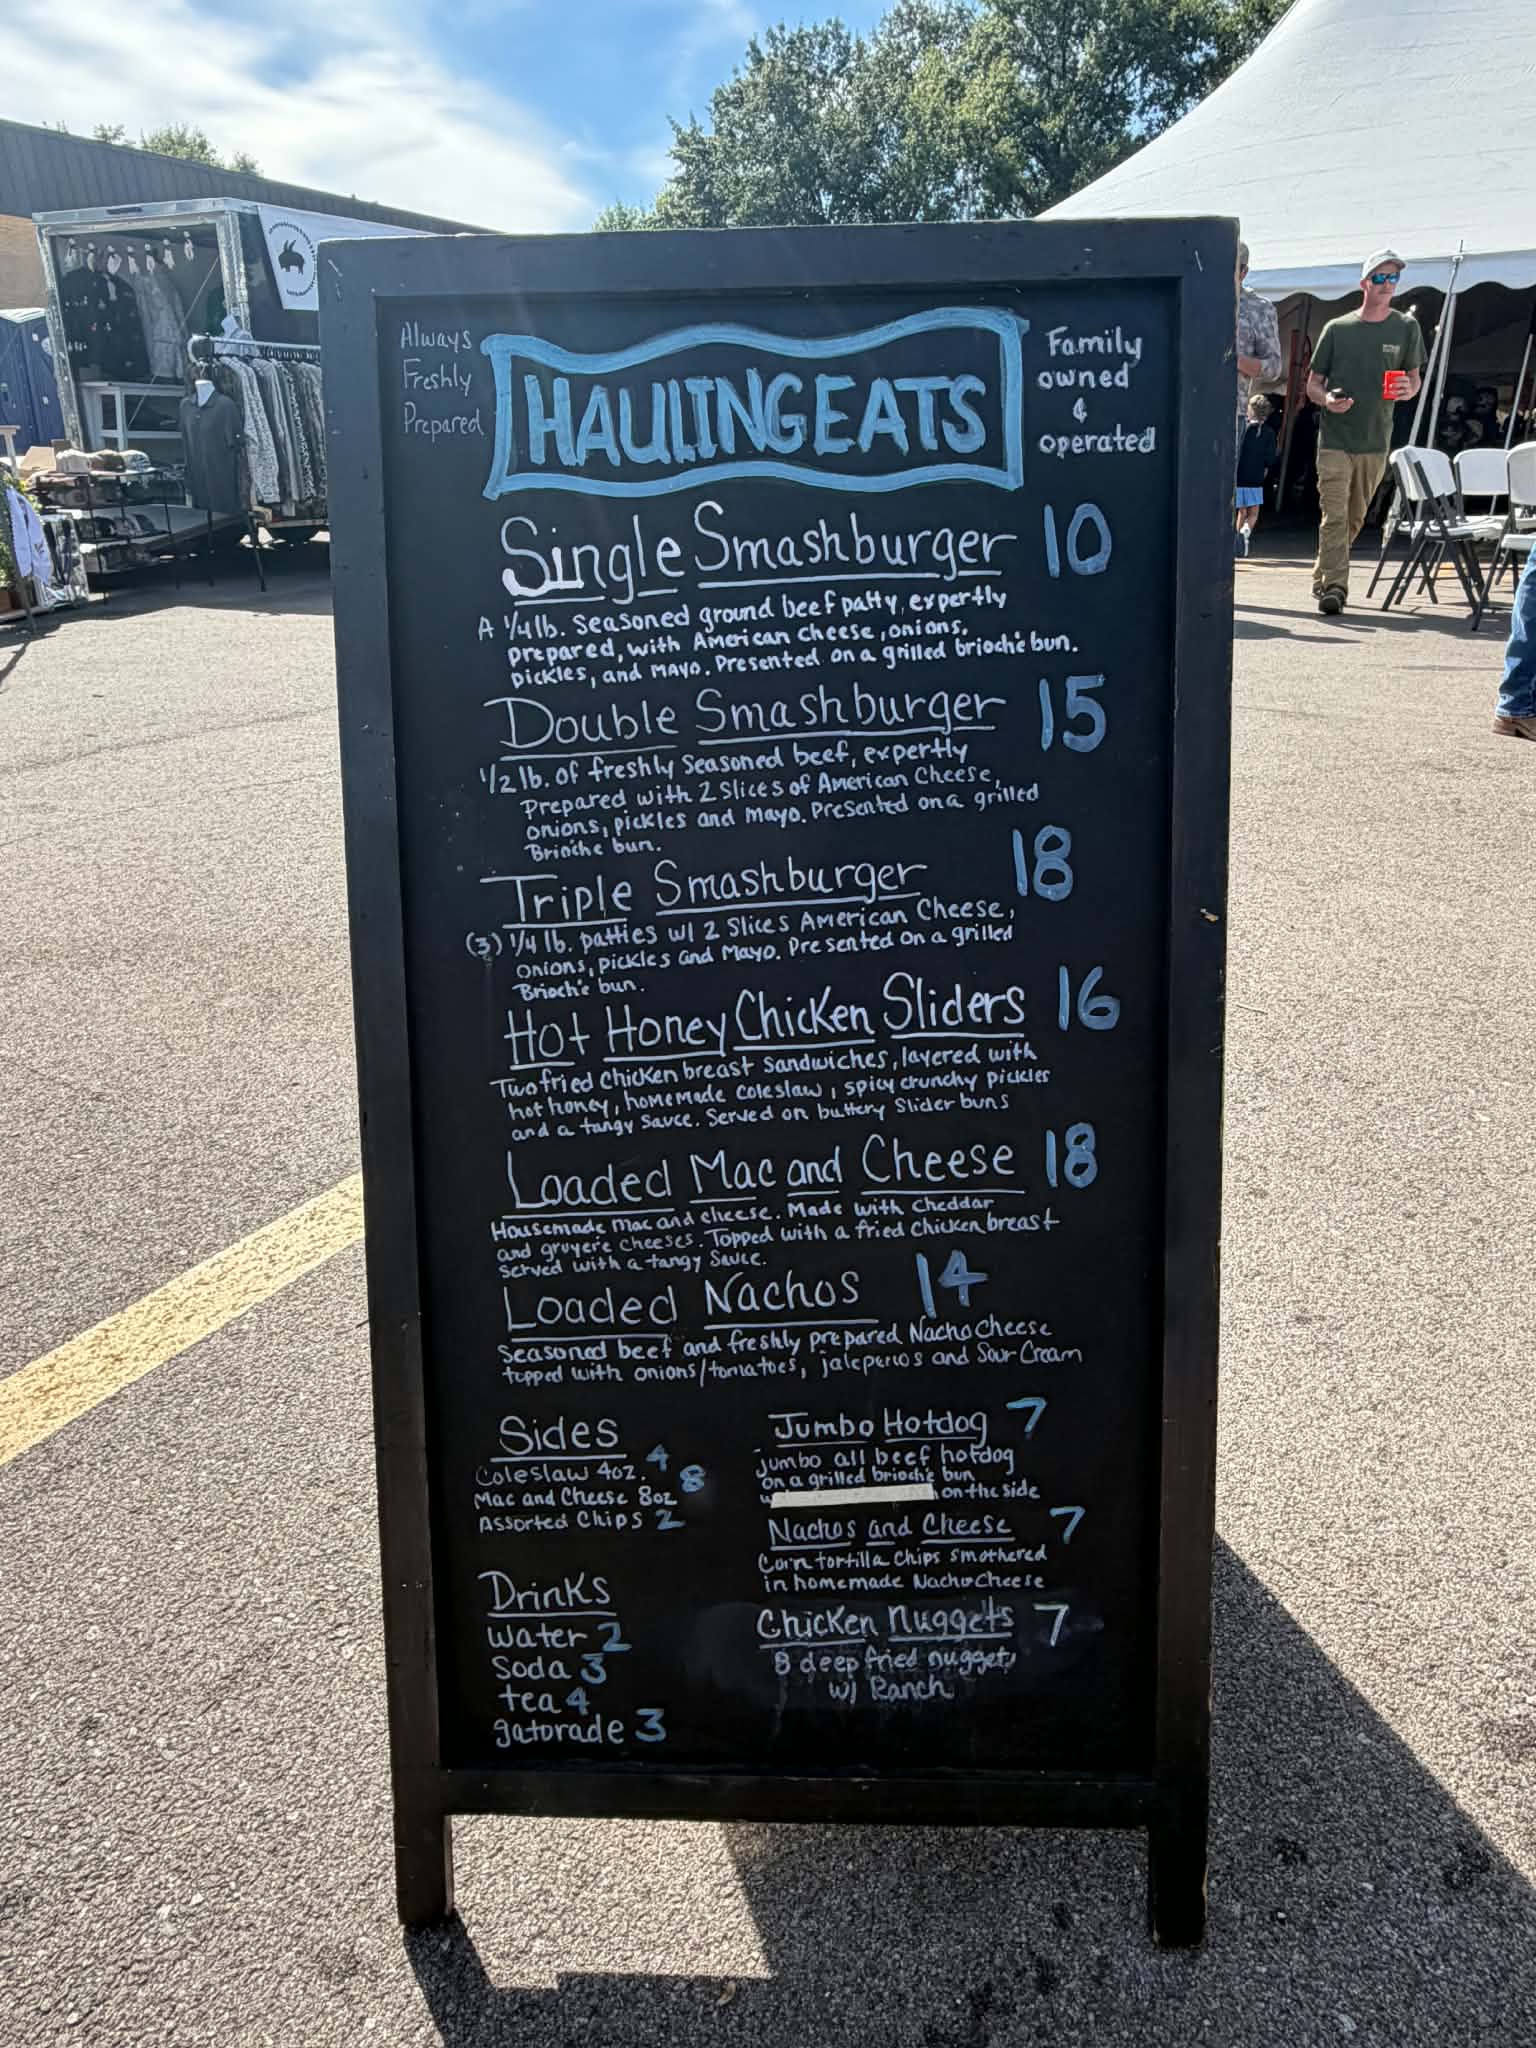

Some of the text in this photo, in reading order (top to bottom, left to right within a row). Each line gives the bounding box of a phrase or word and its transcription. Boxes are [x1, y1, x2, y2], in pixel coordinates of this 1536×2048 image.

[401, 323, 472, 352] Always
[1045, 325, 1142, 361] Family
[403, 359, 471, 396] Freshly
[1038, 363, 1129, 389] owned
[403, 402, 484, 442] Prepared
[814, 374, 986, 455] EATS
[1039, 424, 1155, 458] operated
[501, 500, 1112, 604] Single Smashburger 10
[478, 585, 1007, 640] A ground beef expertly
[603, 632, 1079, 683] and Presented on grilled bun.
[627, 628, 790, 657] with American
[484, 675, 1106, 752] Double Smashburger 15
[556, 764, 578, 785] of
[588, 756, 673, 782] freshly
[793, 740, 856, 768] beef,
[864, 738, 967, 765] expertly
[637, 771, 907, 806] with 2 of American
[614, 810, 686, 837] pickles
[698, 809, 735, 827] and
[975, 784, 1038, 811] grilled
[612, 837, 661, 852] bun.
[480, 825, 1073, 922] Triple Smashburger 18
[580, 924, 657, 948] patties
[704, 922, 720, 939] 2
[801, 907, 908, 932] American
[599, 951, 670, 972] pickles
[678, 950, 713, 965] and
[952, 924, 1013, 947] grilled
[599, 977, 644, 992] bun.
[504, 965, 1121, 1064] Hot Honey Chicken Sliders 16
[490, 1041, 1038, 1099] Two fried breast layered with
[509, 1068, 1051, 1120] hot homemade spicy crunchy pickles
[512, 1092, 1009, 1141] and a tangy Served on buttery buns
[507, 1122, 1098, 1209] Loaded Mac and Cheese 18
[491, 1221, 605, 1241] Housemade
[656, 1212, 695, 1230] and
[854, 1198, 904, 1217] with
[497, 1207, 1061, 1263] and Topped with a fried breast
[573, 1253, 702, 1273] with tangy
[503, 1250, 989, 1332] Loaded Nachos 14
[618, 1325, 903, 1360] beef and freshly prepared
[502, 1365, 562, 1387] topped
[572, 1363, 623, 1382] with
[932, 1347, 969, 1366] and
[500, 1415, 619, 1456] Sides
[768, 1397, 1046, 1450] Jumbo Hotdog 7
[475, 1463, 589, 1487] Coleslaw
[646, 1444, 669, 1472] 4
[762, 1466, 975, 1490] on a grilled bun
[834, 1445, 1014, 1475] all beef hotdog
[474, 1492, 515, 1510] Mac
[523, 1489, 556, 1506] and
[680, 1464, 705, 1493] 8
[1002, 1479, 1040, 1499] side
[479, 1509, 686, 1534] Assorted Chips 2
[768, 1506, 1085, 1545] Nachos and Cheese 7
[817, 1544, 1047, 1568] tortilla smothered
[477, 1571, 611, 1610] Drinks
[764, 1574, 904, 1592] in homemade
[598, 1622, 632, 1652] 2
[756, 1606, 878, 1640] Chicken
[1033, 1603, 1070, 1647] 7
[580, 1653, 607, 1684] 3
[800, 1652, 859, 1679] deep
[865, 1646, 917, 1670] fried
[498, 1684, 590, 1715] tea 4
[870, 1676, 954, 1700] Ranch
[494, 1708, 666, 1748] gatorade 3
